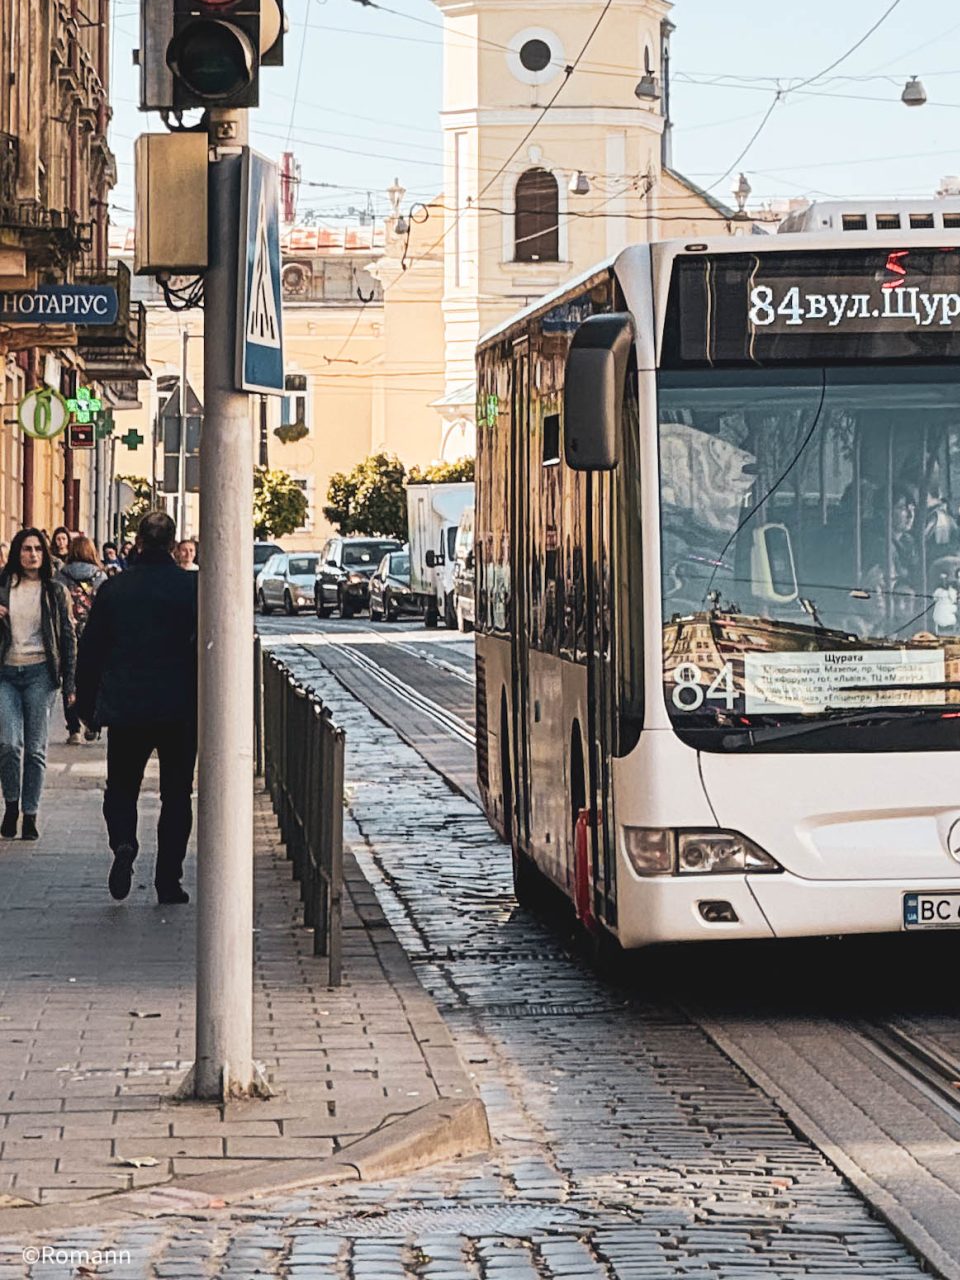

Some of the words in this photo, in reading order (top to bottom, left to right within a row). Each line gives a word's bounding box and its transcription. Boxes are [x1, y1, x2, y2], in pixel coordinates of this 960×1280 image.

[2, 294, 108, 315] НОТАРІУС
[824, 654, 863, 664] Щурата
[672, 662, 740, 711] 84
[921, 900, 950, 921] BC
